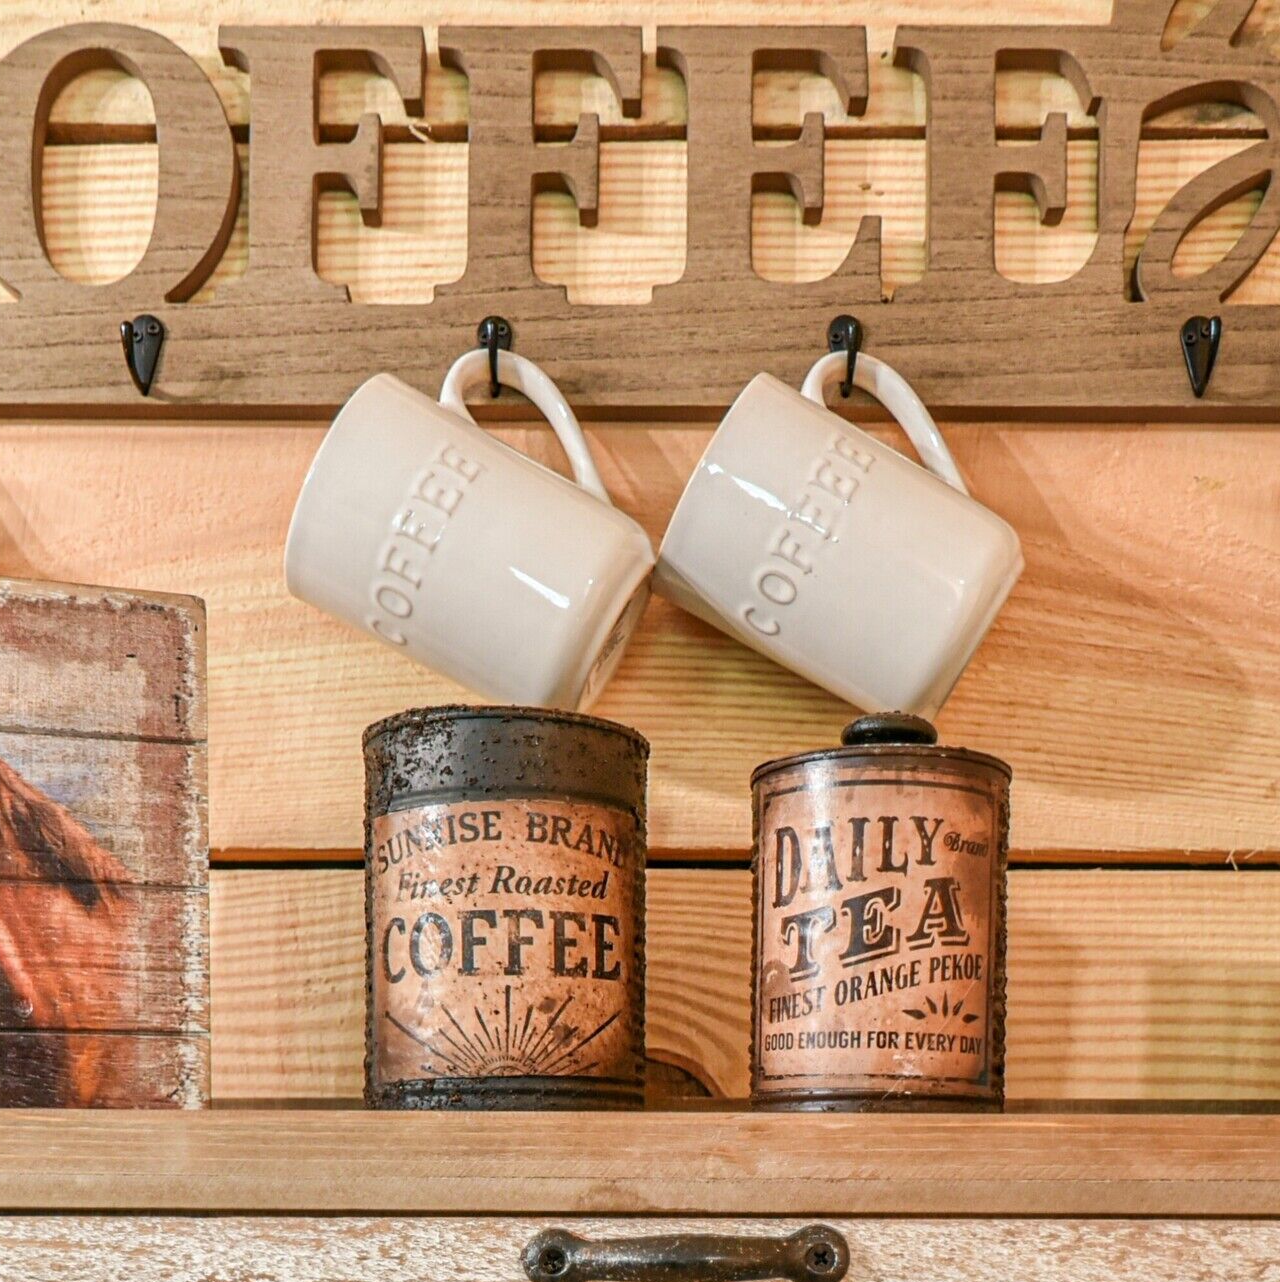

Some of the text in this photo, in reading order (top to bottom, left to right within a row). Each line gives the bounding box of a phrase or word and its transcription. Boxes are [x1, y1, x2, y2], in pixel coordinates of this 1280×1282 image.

[371, 441, 490, 647] COFFEE
[744, 433, 878, 638] COFFEE
[377, 810, 503, 874] SUNRISE
[771, 815, 990, 910] DAILY Brand
[397, 864, 611, 901] Finest Roasted
[381, 909, 622, 984] COFFEE
[780, 876, 970, 983] TEA
[768, 953, 984, 1025] FINEST ORANGE PEKOE
[763, 1030, 983, 1055] GOOD ENOUGH FOR EVERY DAY
